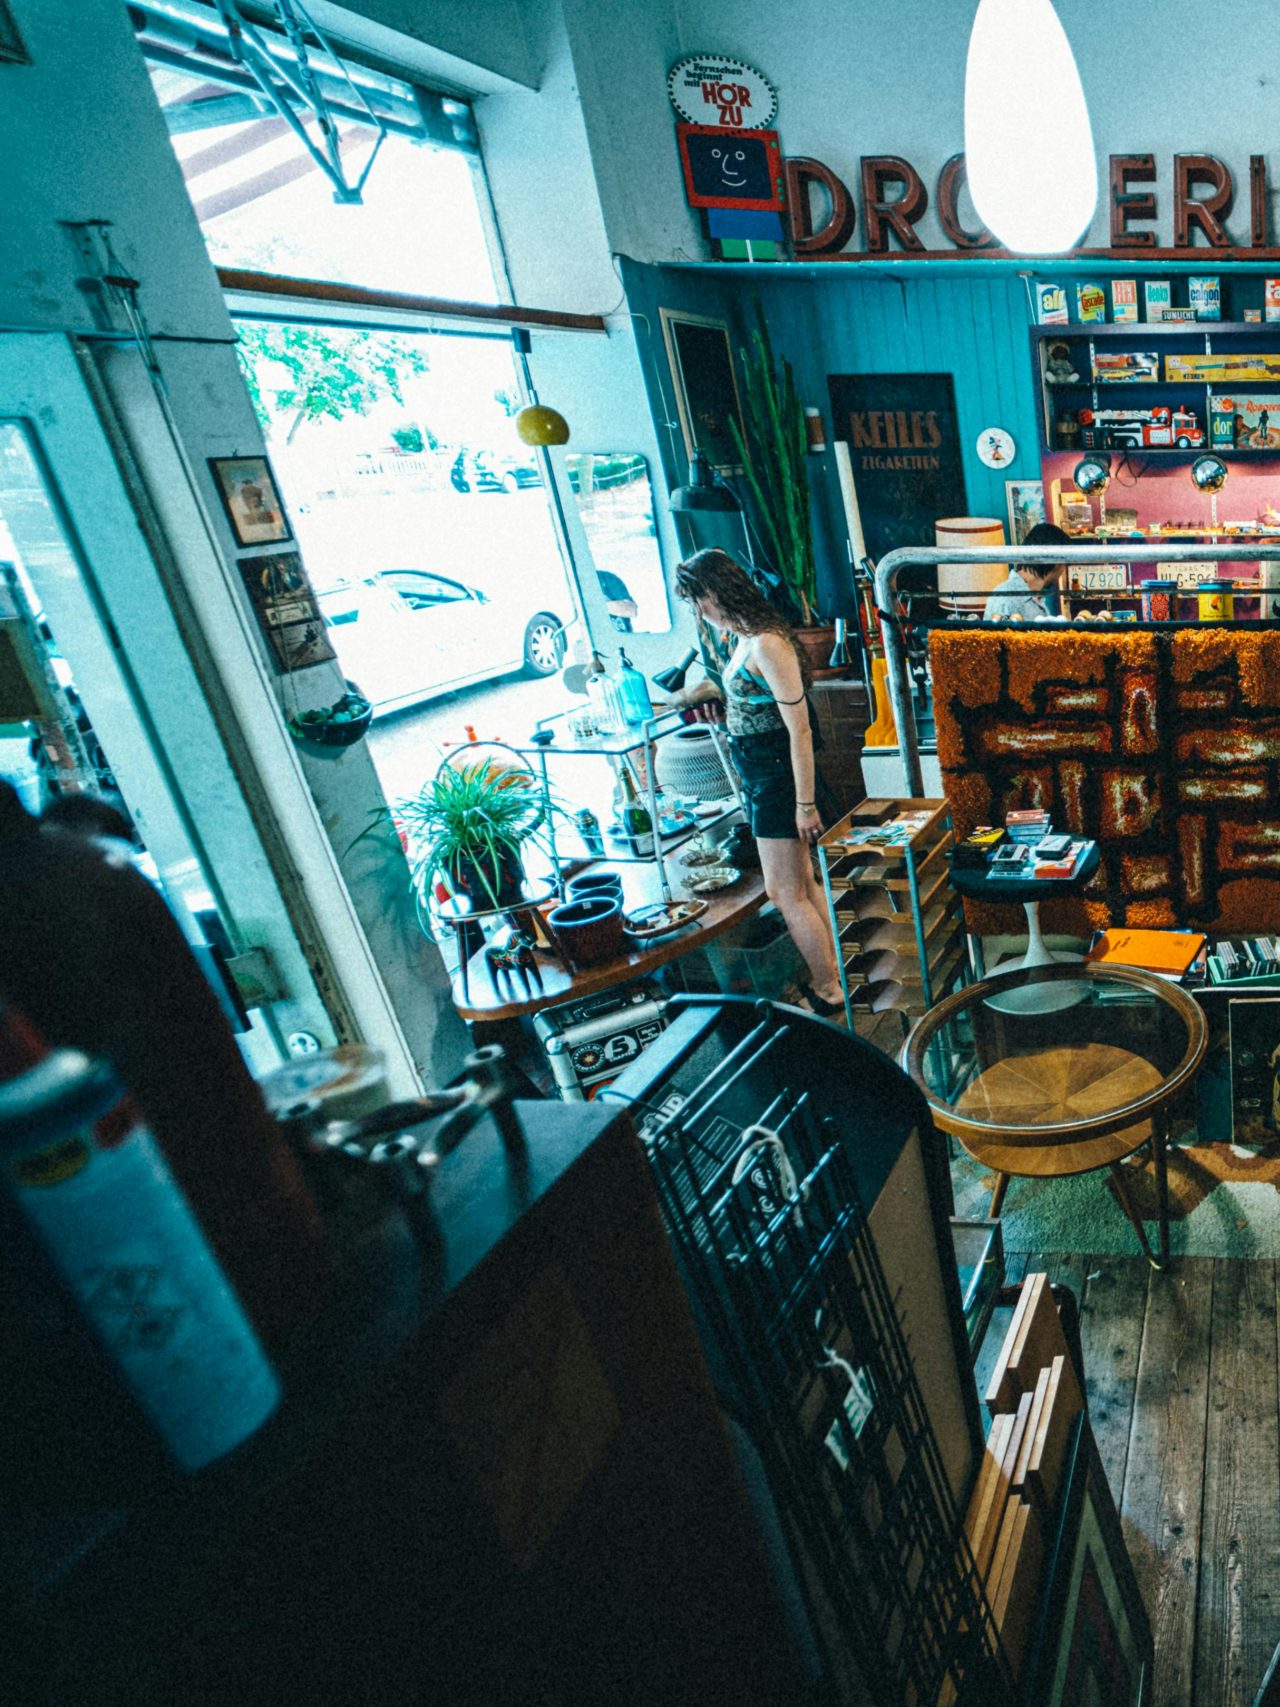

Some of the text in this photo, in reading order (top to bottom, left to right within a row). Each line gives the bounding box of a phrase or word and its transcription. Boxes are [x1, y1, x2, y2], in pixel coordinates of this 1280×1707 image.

[684, 79, 701, 87] mit
[686, 70, 723, 81] beginnt
[701, 81, 752, 107] HÖR
[717, 104, 743, 126] ZU
[1190, 284, 1219, 306] calgon
[1162, 310, 1195, 320] SUNLICHT
[1213, 417, 1233, 436] dor
[1098, 572, 1123, 588] 920
